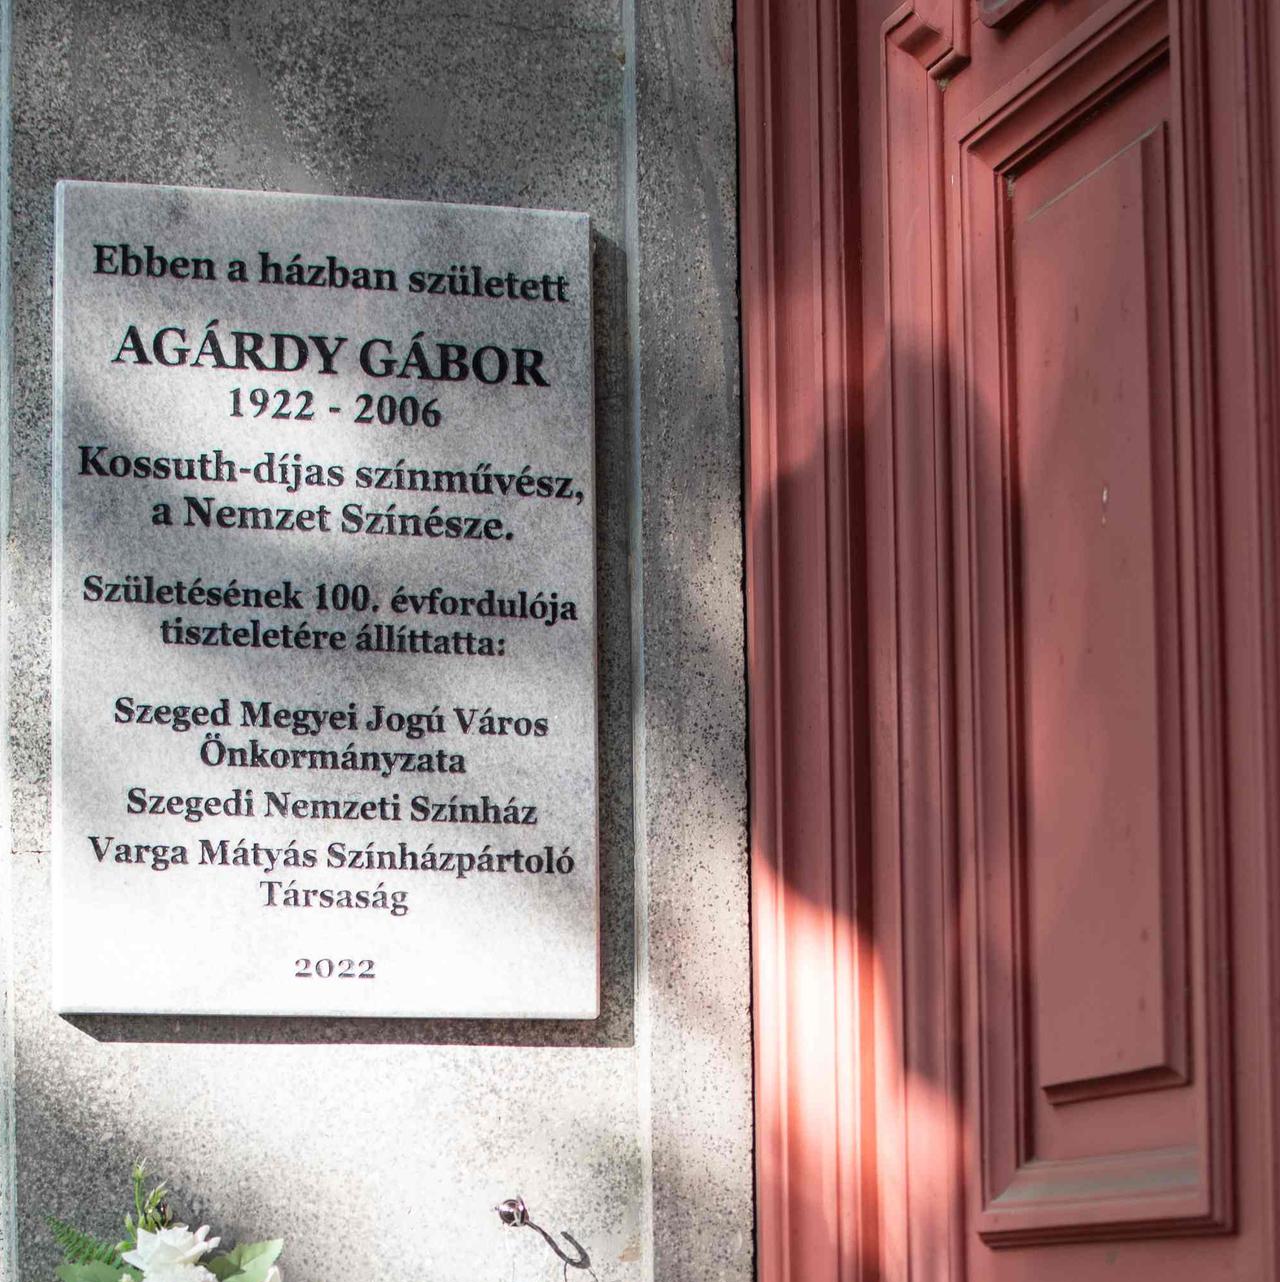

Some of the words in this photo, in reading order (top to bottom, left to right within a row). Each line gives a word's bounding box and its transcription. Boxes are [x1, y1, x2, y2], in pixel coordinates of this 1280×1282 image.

[92, 244, 217, 281] Ebben
[226, 261, 249, 282] a
[259, 250, 398, 292] házban
[408, 263, 570, 303] született
[111, 319, 346, 375] AGÁRDY
[358, 331, 551, 388] GÁBOR
[227, 387, 315, 421] 1922
[328, 406, 341, 414] -
[354, 393, 442, 428] 2006
[77, 445, 344, 493] Kossuth-díjas
[355, 456, 585, 505] színművész,
[151, 504, 173, 527] a
[183, 495, 331, 533] Nemzet
[340, 503, 514, 542] Színésze.
[82, 574, 303, 611] Születésének
[315, 584, 379, 614] 100.
[390, 591, 578, 627] évfordulója
[158, 617, 347, 652] tiszteletére
[355, 623, 507, 657] állíttatta:
[113, 696, 231, 732] Szeged
[240, 699, 358, 735] Megyei
[366, 705, 446, 738] Jogú
[452, 706, 549, 738] Város
[199, 733, 467, 777] Önkormányzata
[125, 787, 256, 824] Szegedi
[263, 791, 402, 823] Nemzeti
[409, 793, 539, 826] Színház
[87, 835, 189, 871] Varga
[198, 838, 318, 873] Mátyás
[326, 841, 576, 879] Színházpártoló
[259, 879, 410, 917] Társaság
[293, 957, 377, 980] 2022
